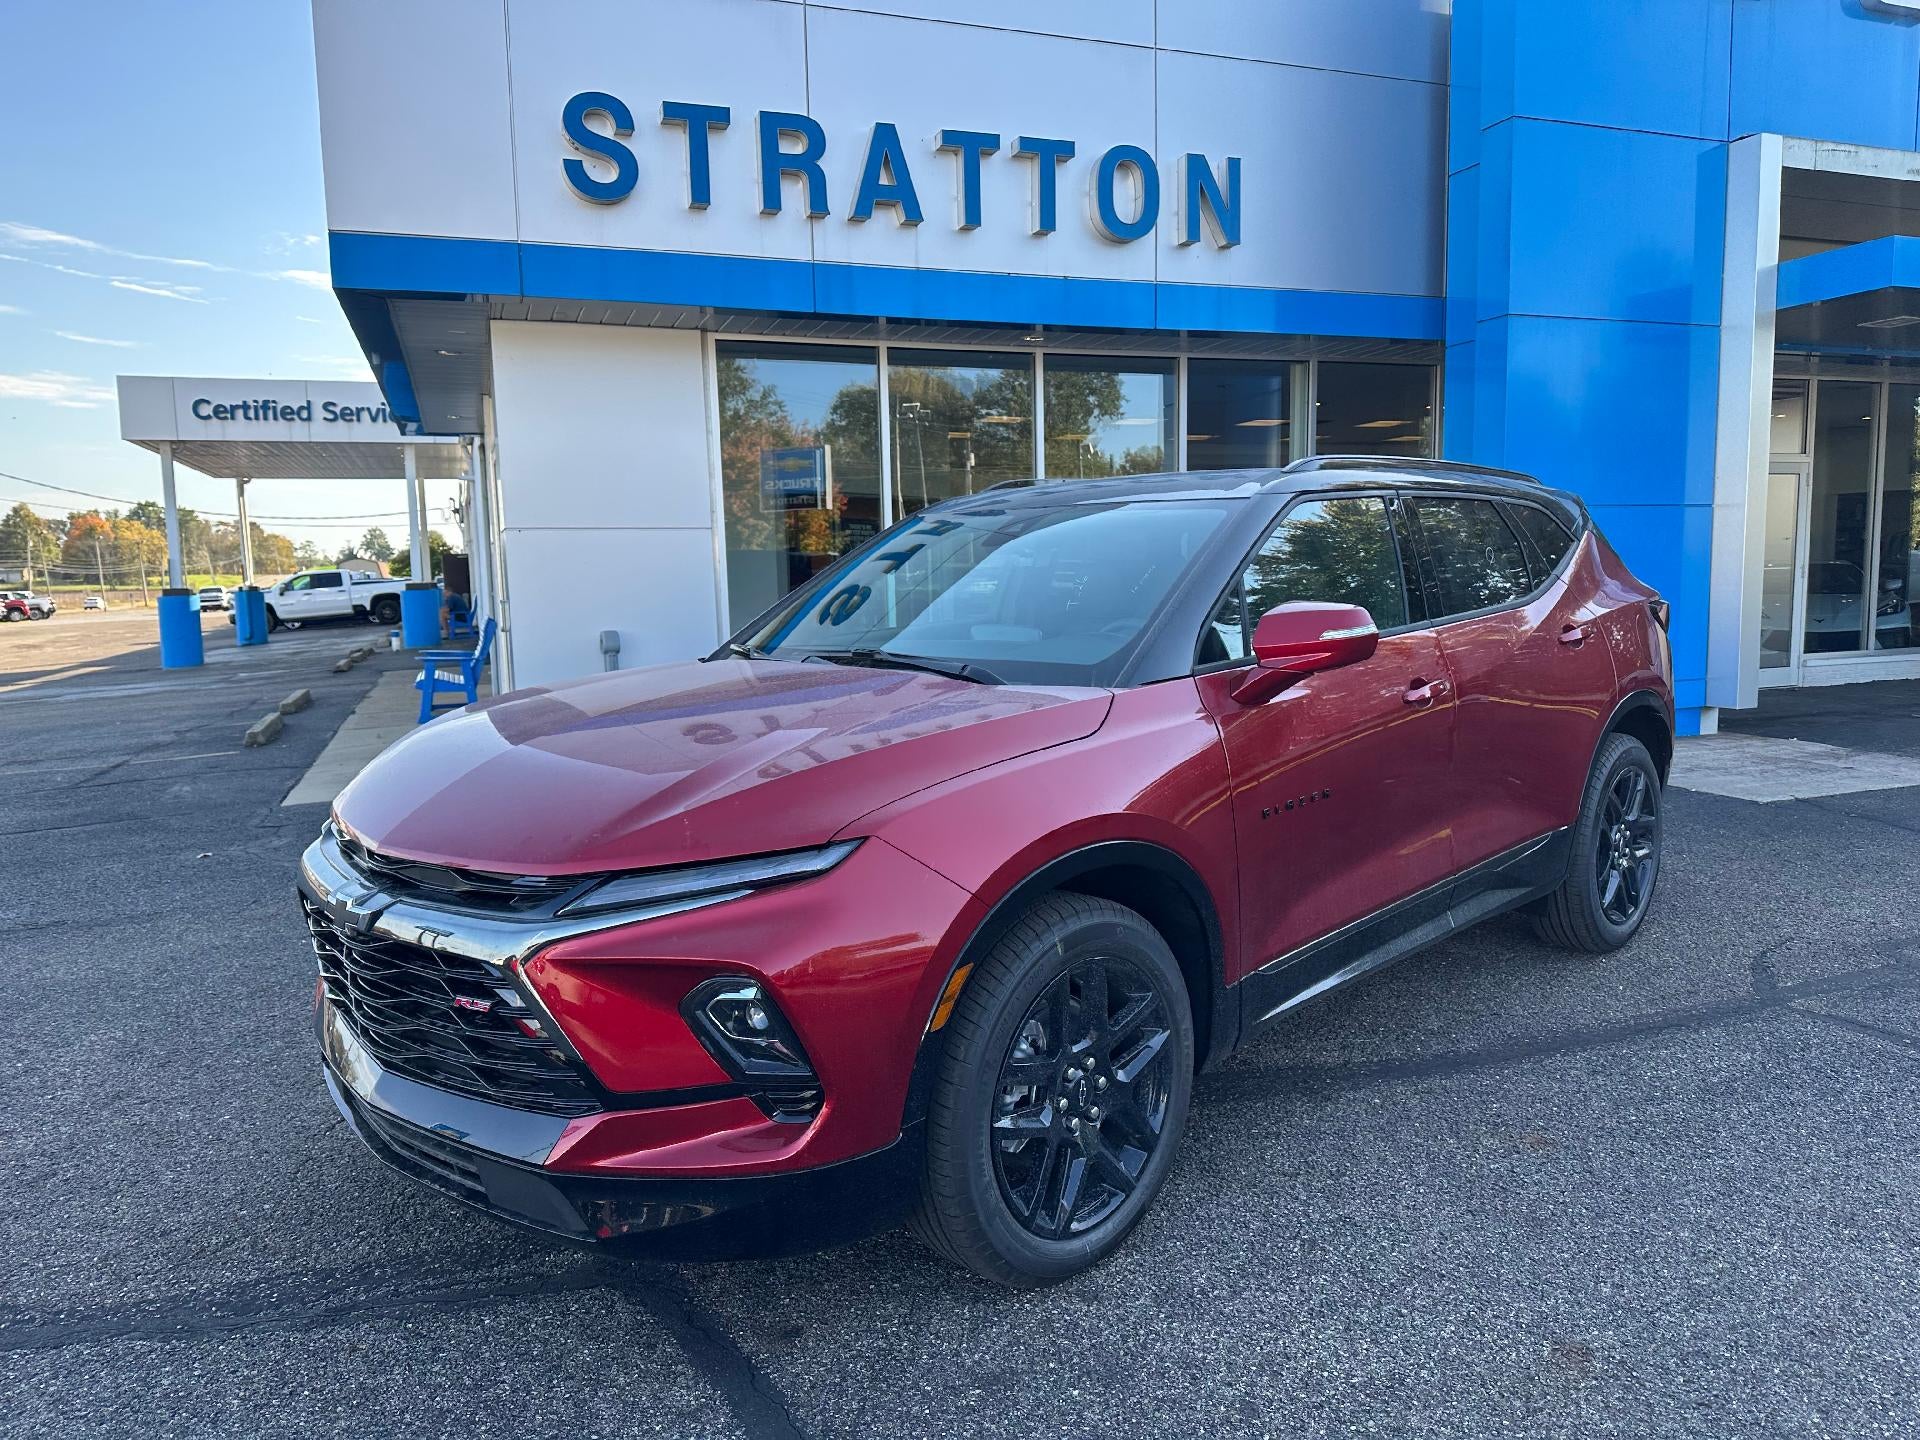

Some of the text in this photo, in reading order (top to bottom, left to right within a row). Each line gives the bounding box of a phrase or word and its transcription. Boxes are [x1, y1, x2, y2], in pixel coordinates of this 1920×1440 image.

[562, 91, 1242, 249] STRATTON
[192, 398, 312, 422] Certified
[453, 996, 491, 1012] RS
